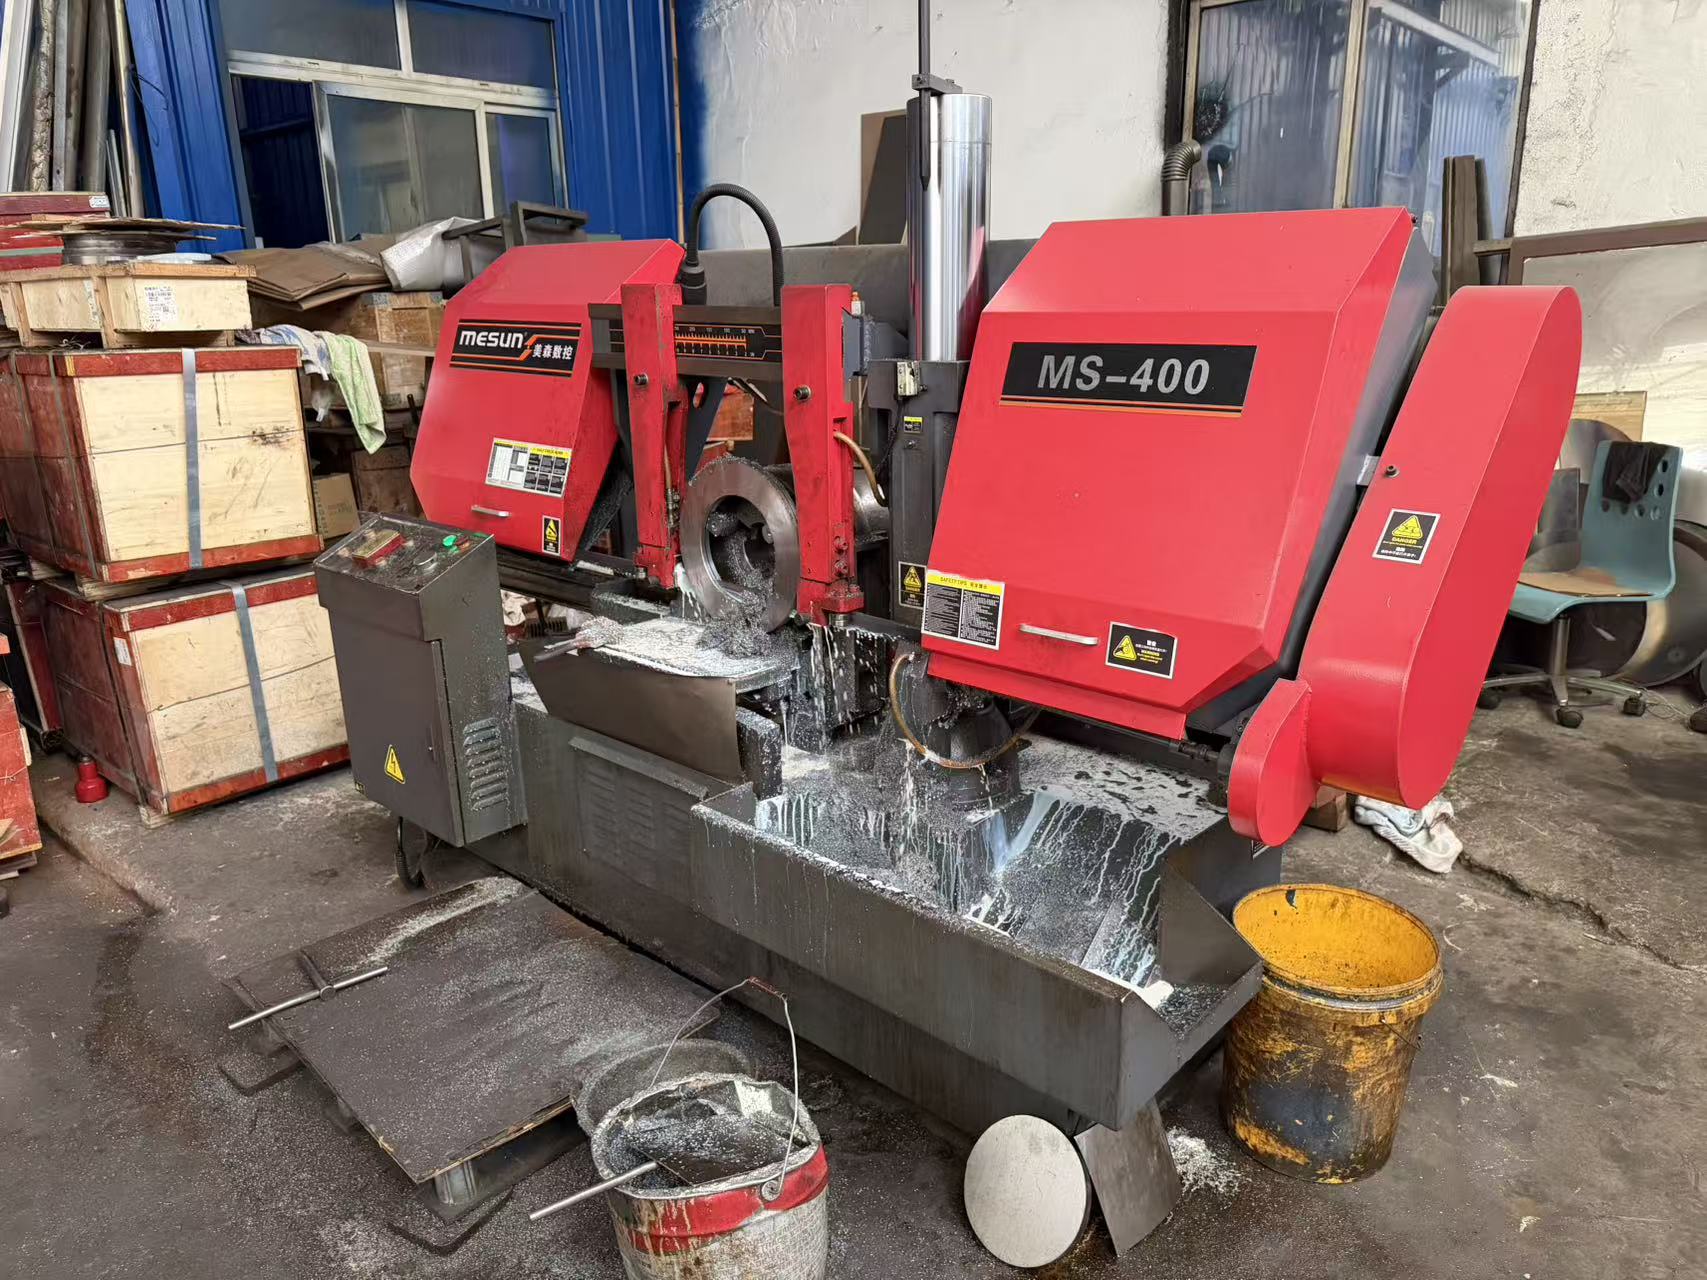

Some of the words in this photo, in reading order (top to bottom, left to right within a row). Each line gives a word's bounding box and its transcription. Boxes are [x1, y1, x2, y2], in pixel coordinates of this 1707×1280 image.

[532, 343, 574, 360] 美森数控
[1037, 354, 1211, 395] MS-400
